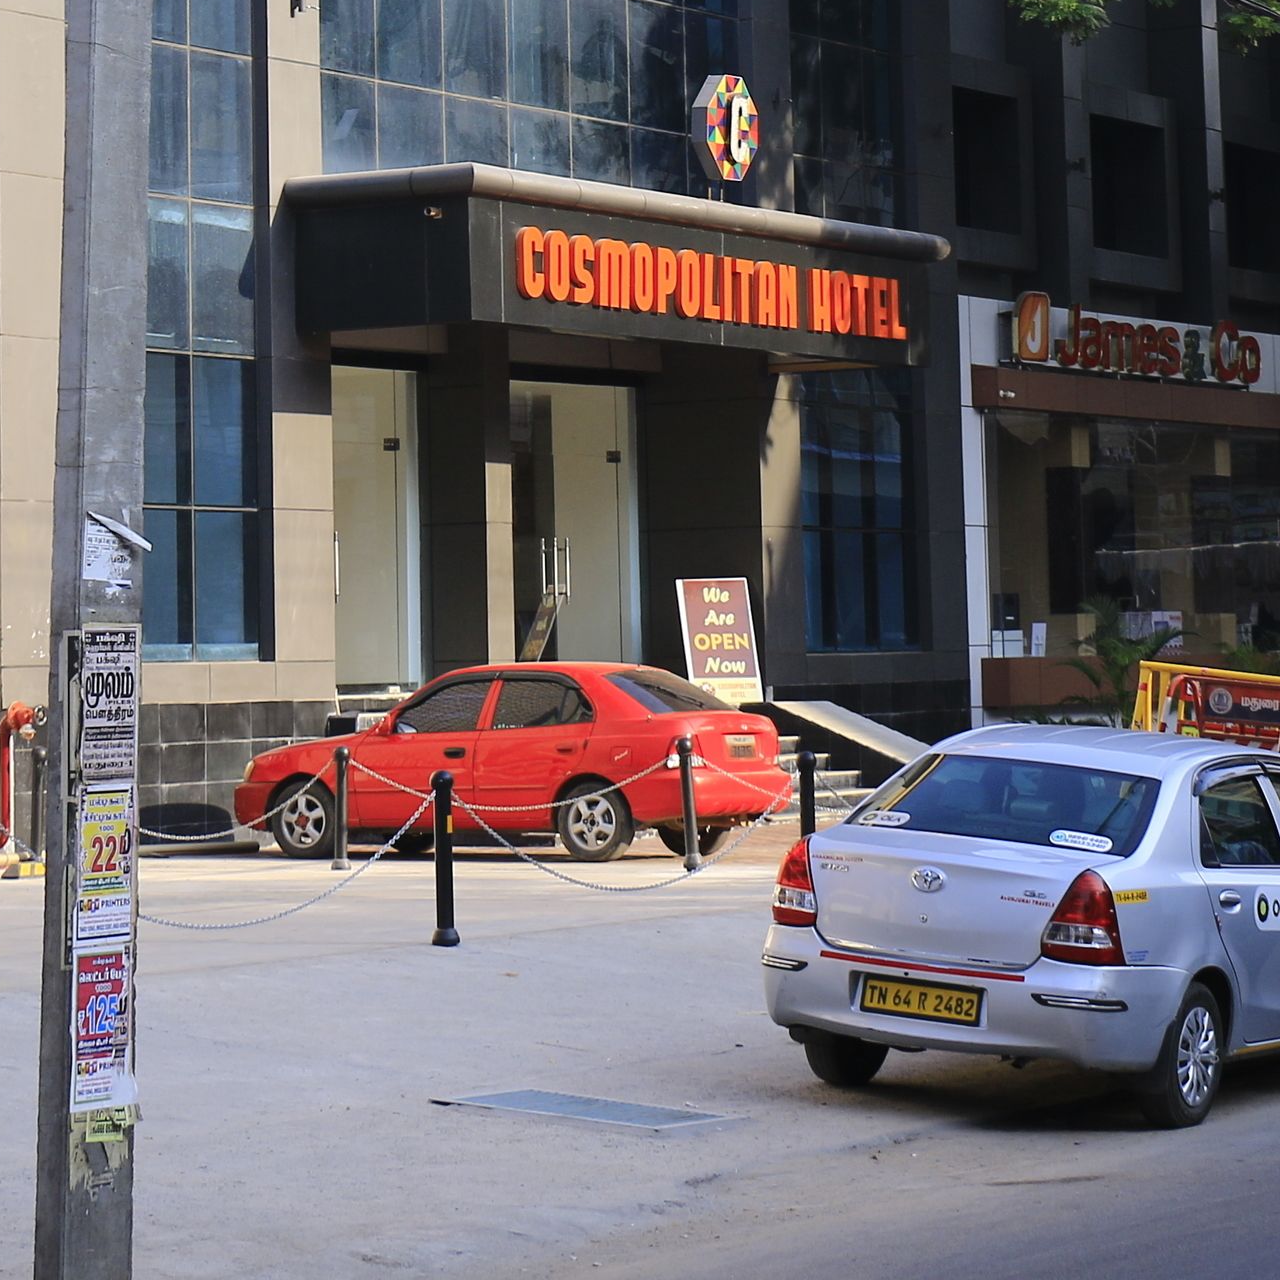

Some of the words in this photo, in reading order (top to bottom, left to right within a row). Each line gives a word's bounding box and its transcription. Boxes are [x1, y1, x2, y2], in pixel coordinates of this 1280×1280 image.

[515, 226, 798, 330] COSMOPOLITAN
[807, 268, 907, 341] HOTEL
[1054, 303, 1181, 376] James
[1182, 329, 1207, 381] &
[1210, 320, 1261, 384] Co
[702, 587, 730, 604] We
[704, 610, 735, 627] Are
[694, 633, 750, 651] OPEN
[704, 657, 746, 674] Now
[85, 666, 134, 709] மூலம்
[1241, 696, 1278, 712] மதுரை
[880, 814, 901, 823] OLA
[101, 898, 131, 908] PRINTERS
[869, 985, 887, 1004] TN
[893, 989, 912, 1008] 64
[917, 991, 928, 1010] R
[933, 994, 975, 1017] 2482
